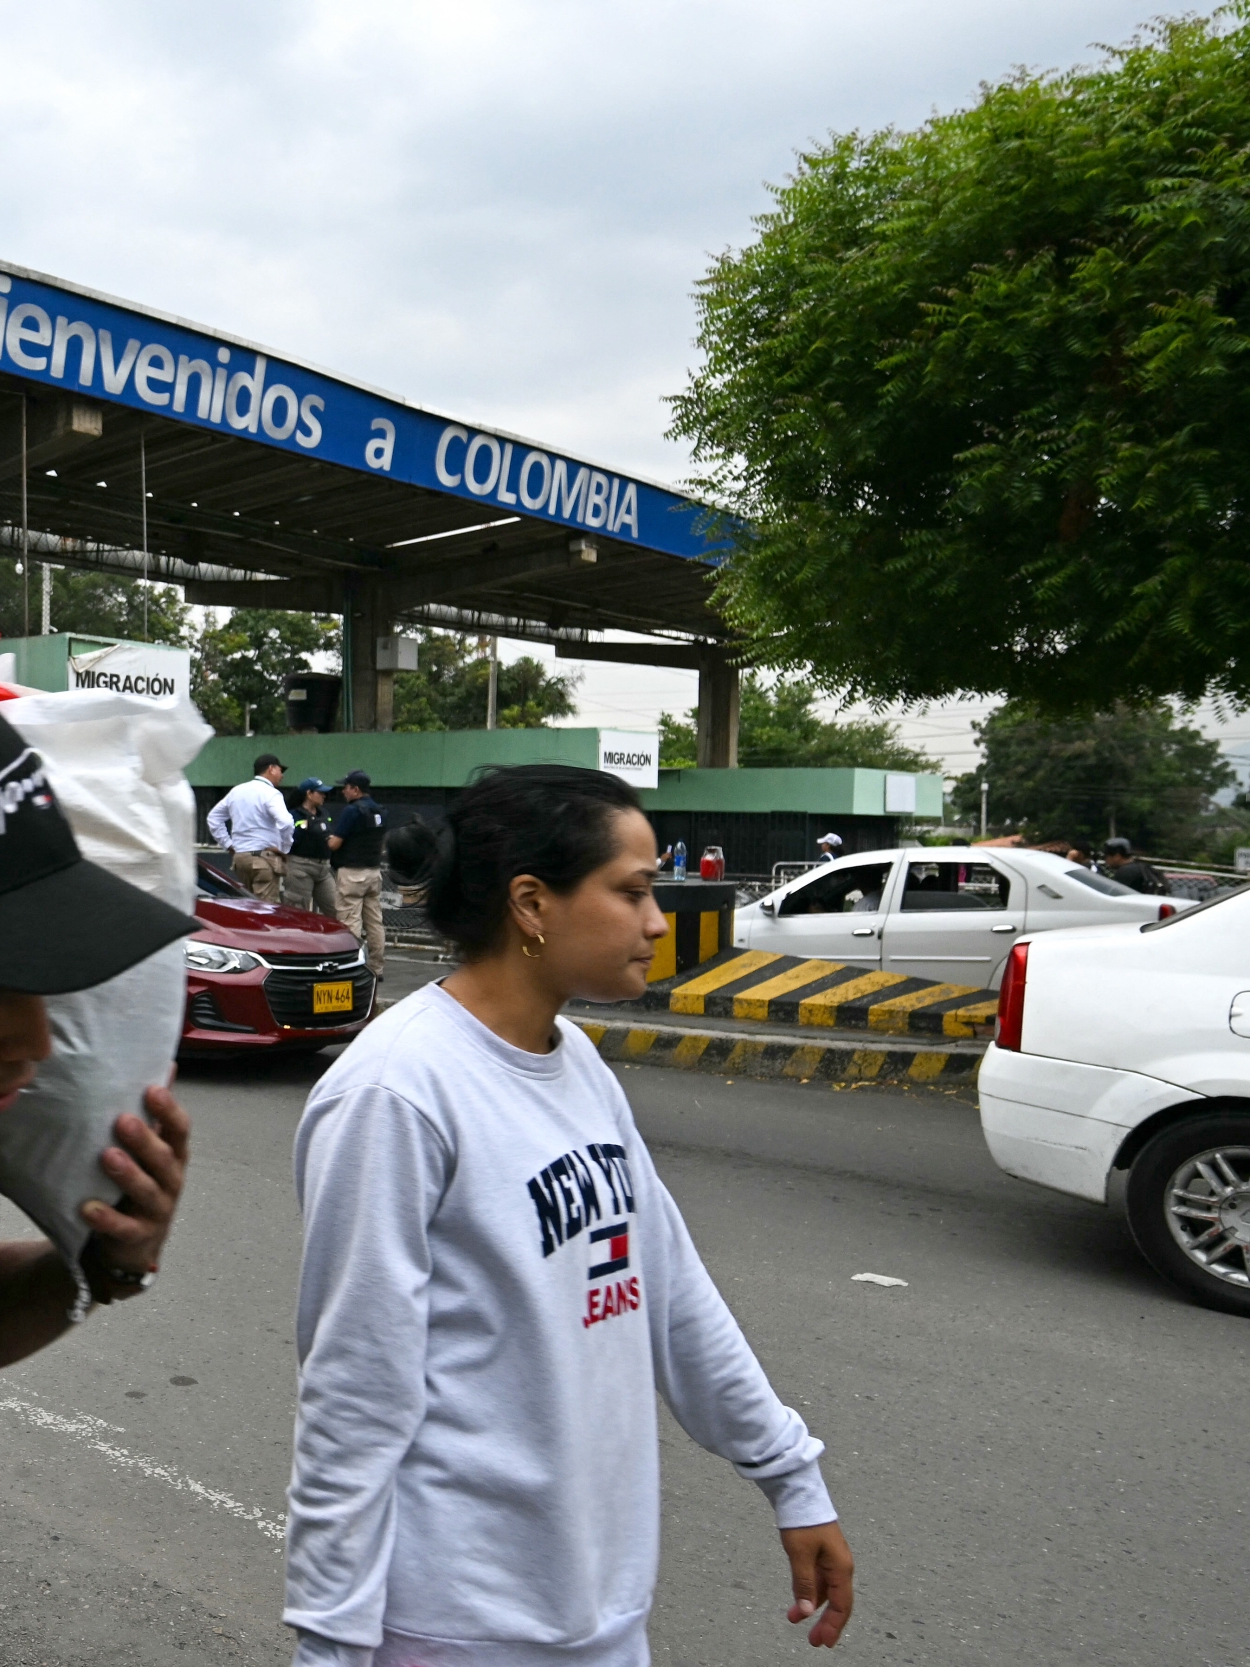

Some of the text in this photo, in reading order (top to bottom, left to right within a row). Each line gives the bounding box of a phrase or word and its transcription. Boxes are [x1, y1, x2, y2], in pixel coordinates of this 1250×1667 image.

[365, 417, 396, 471] a
[434, 424, 639, 539] COLOMBIA
[75, 671, 175, 696] MIGRACIÓN
[603, 750, 652, 767] MIGRACIÓN
[316, 988, 351, 1005] NYN 464
[526, 1150, 602, 1258] NEW
